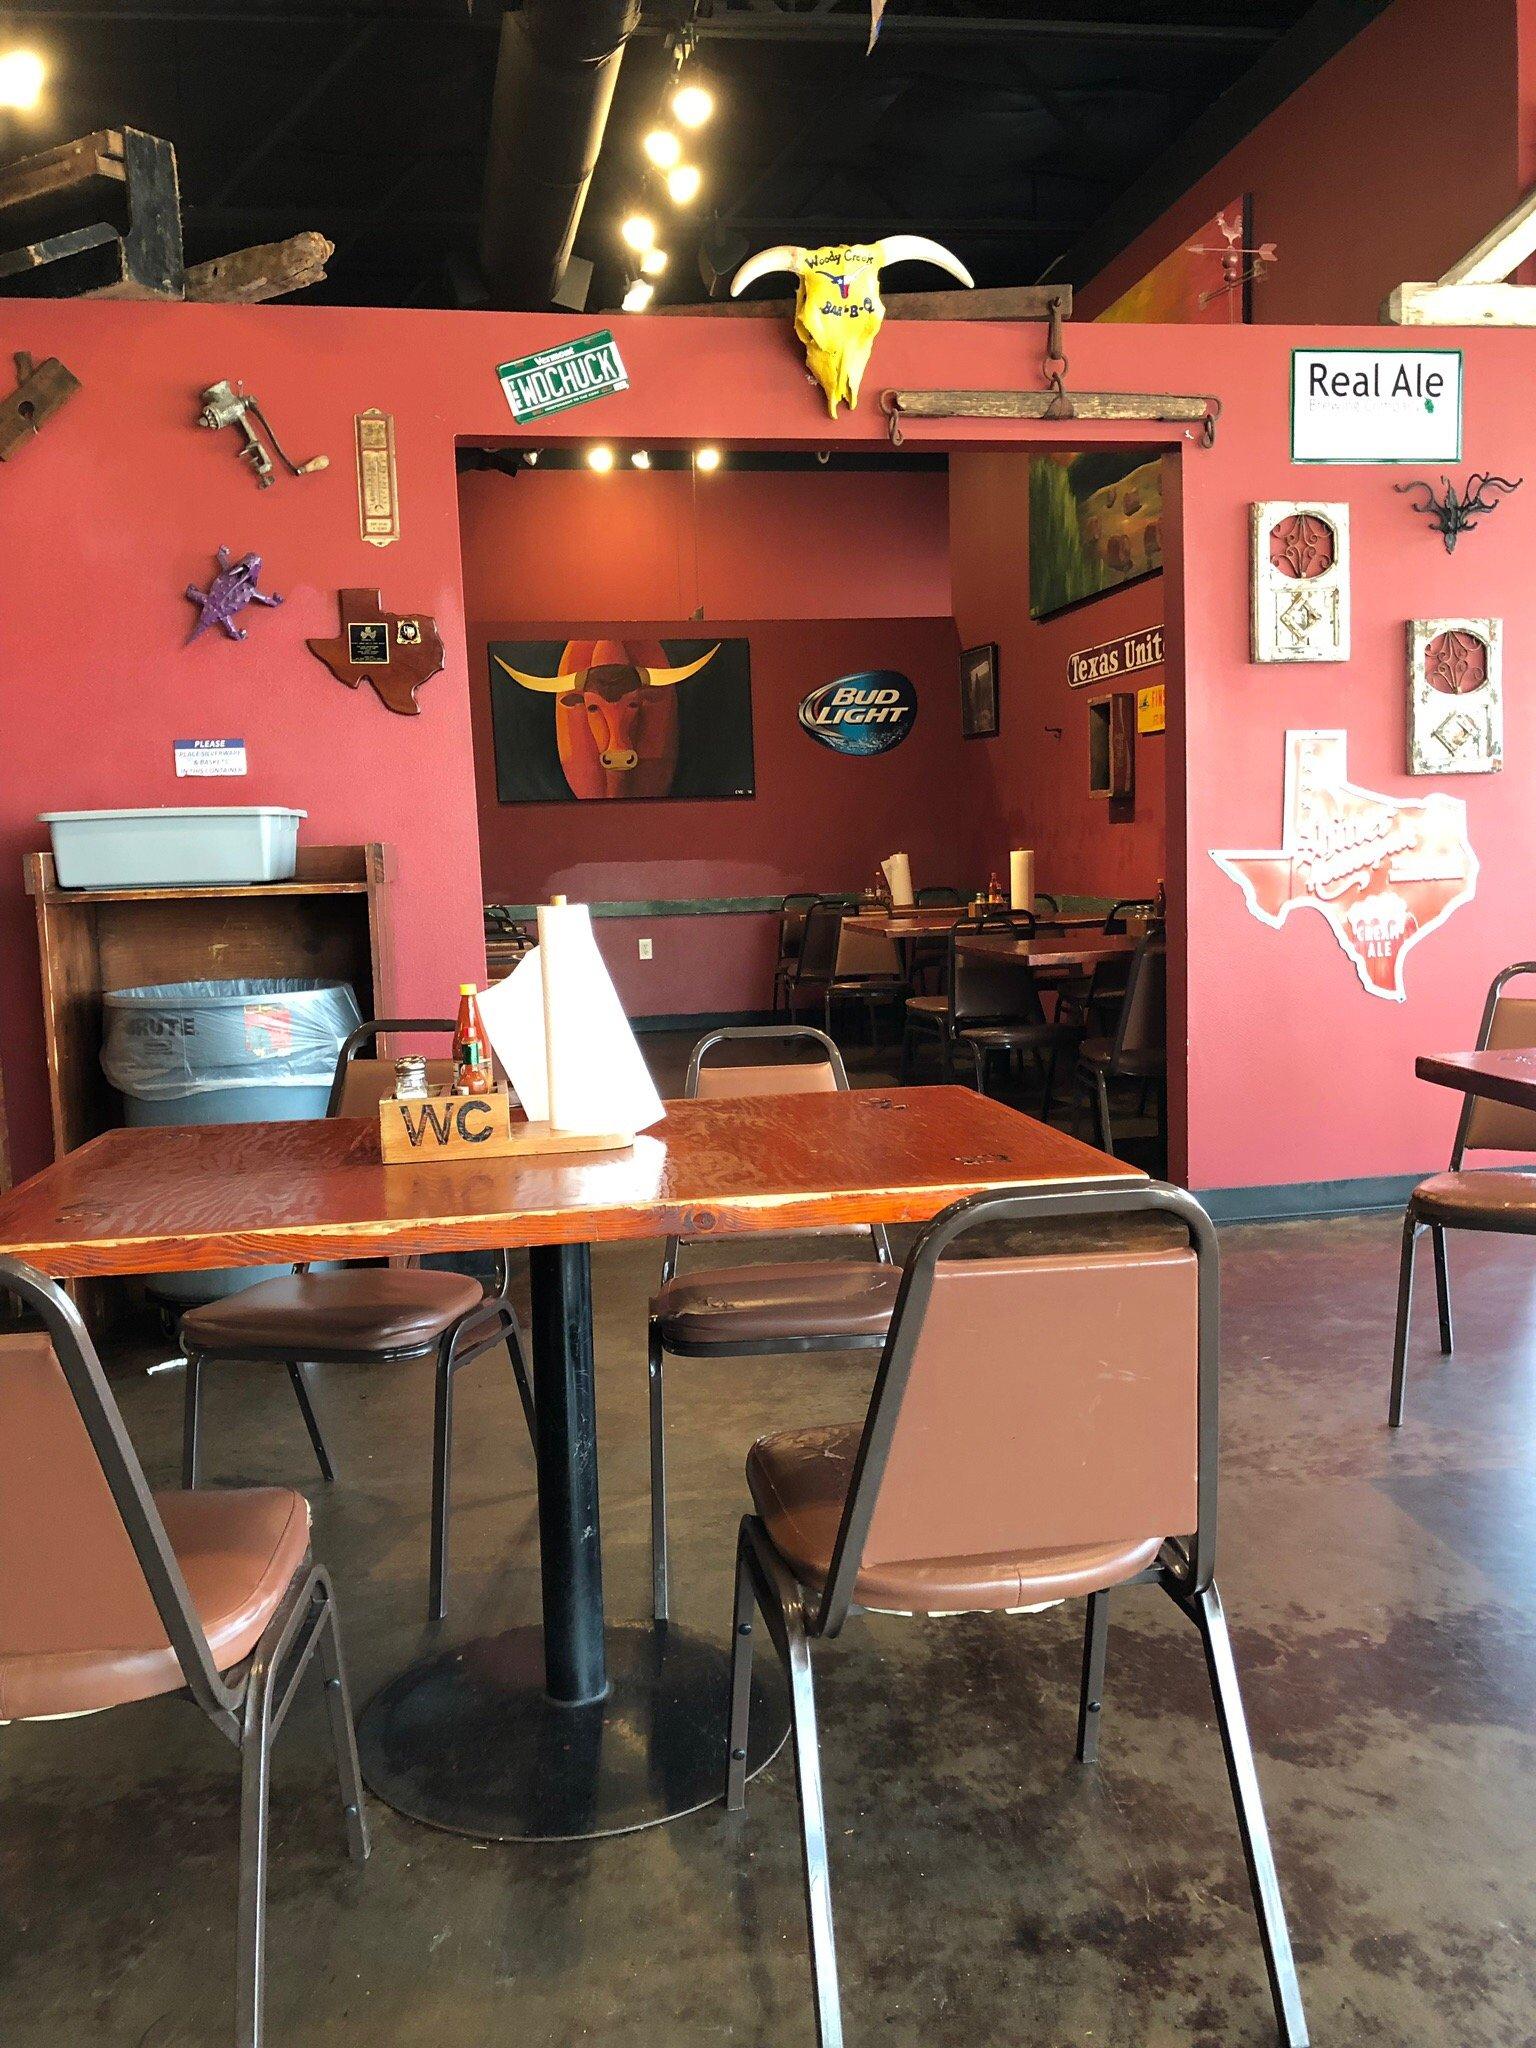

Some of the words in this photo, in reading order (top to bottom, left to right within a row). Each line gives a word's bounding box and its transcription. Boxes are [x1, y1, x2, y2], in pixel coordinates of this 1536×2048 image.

[805, 251, 841, 269] Woody
[1310, 363, 1380, 397] Real
[1391, 363, 1444, 397] Ale
[1071, 649, 1119, 682] Texas
[1124, 632, 1165, 668] Unit
[831, 687, 900, 706] BUD
[816, 706, 909, 725] LIGHT
[194, 739, 226, 748] PLEASE
[1367, 941, 1393, 958] ALE
[399, 1100, 494, 1147] WC
